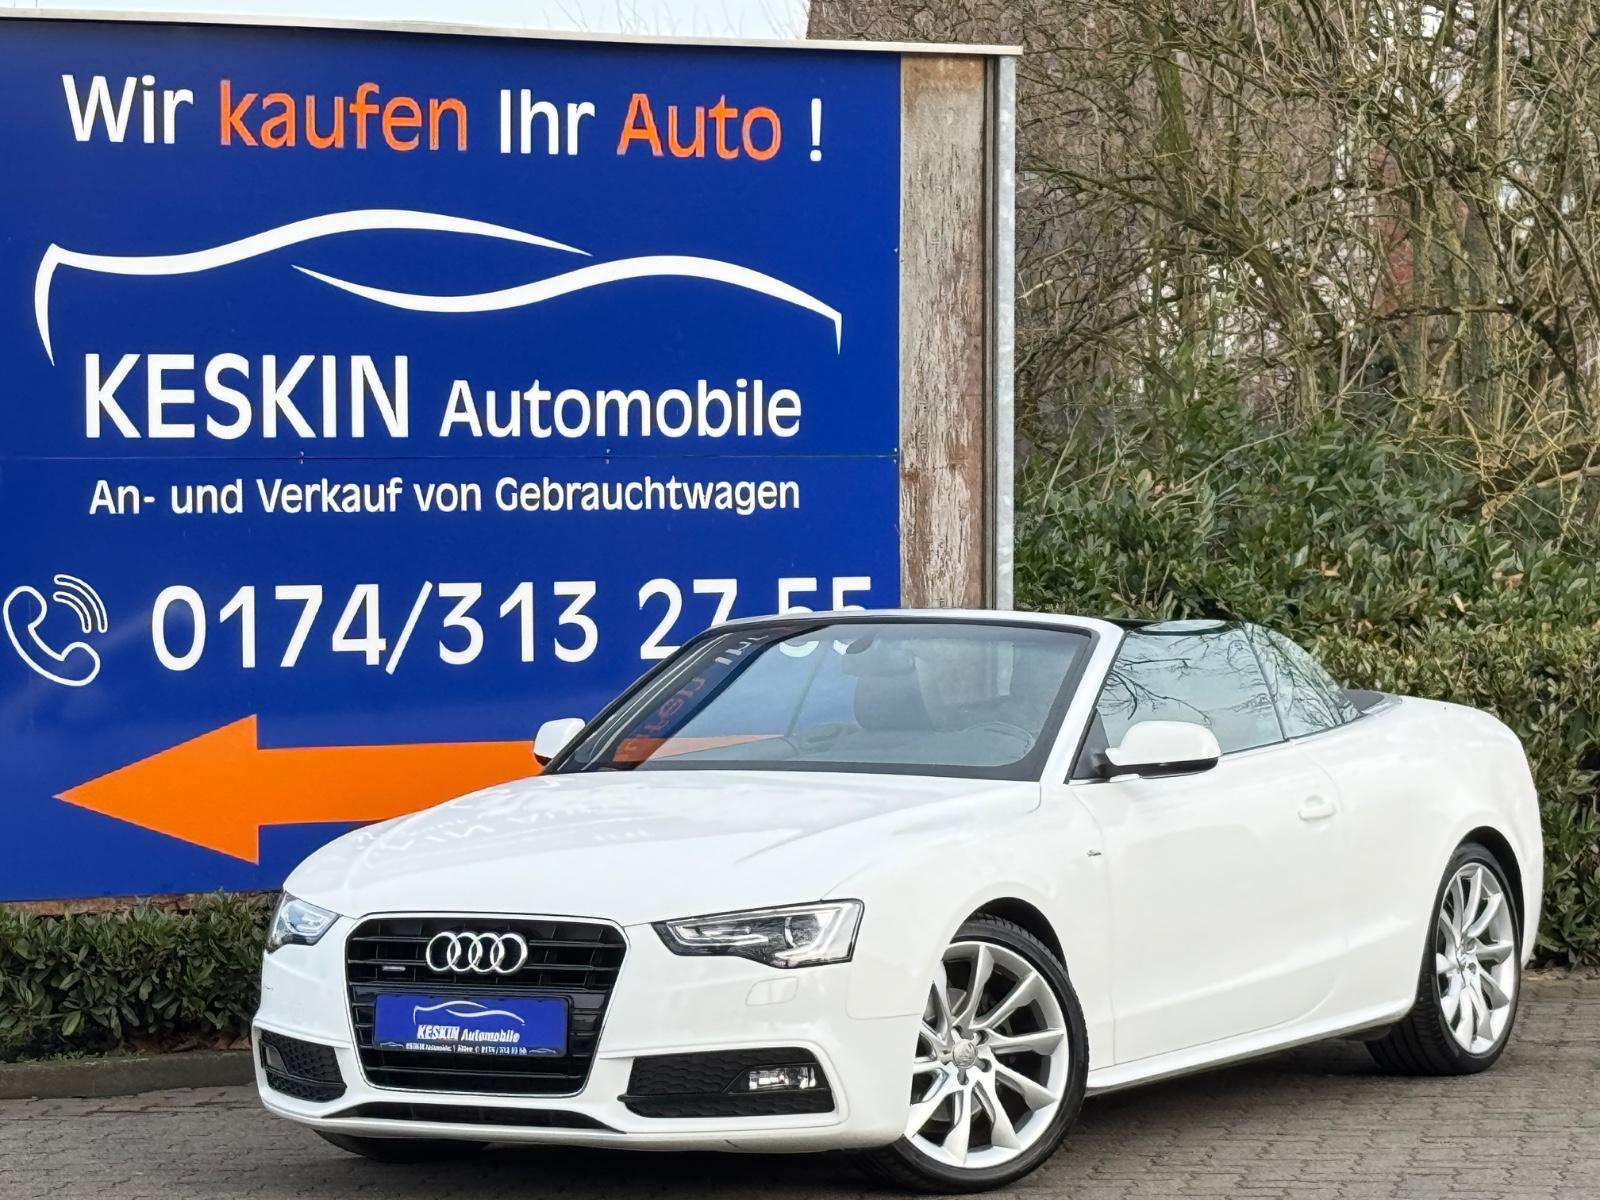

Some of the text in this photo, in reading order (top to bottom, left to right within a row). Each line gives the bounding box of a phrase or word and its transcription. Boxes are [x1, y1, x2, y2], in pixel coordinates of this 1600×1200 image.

[61, 74, 823, 162] Wir kaufen Ihr Auto !
[84, 353, 802, 439] KESKIN Automobile
[89, 475, 800, 515] An- und Verkauf von Gebrauchtwagen
[151, 580, 598, 675] 0174/313
[638, 577, 738, 660] 27
[416, 1024, 521, 1043] KESKIN Automobile
